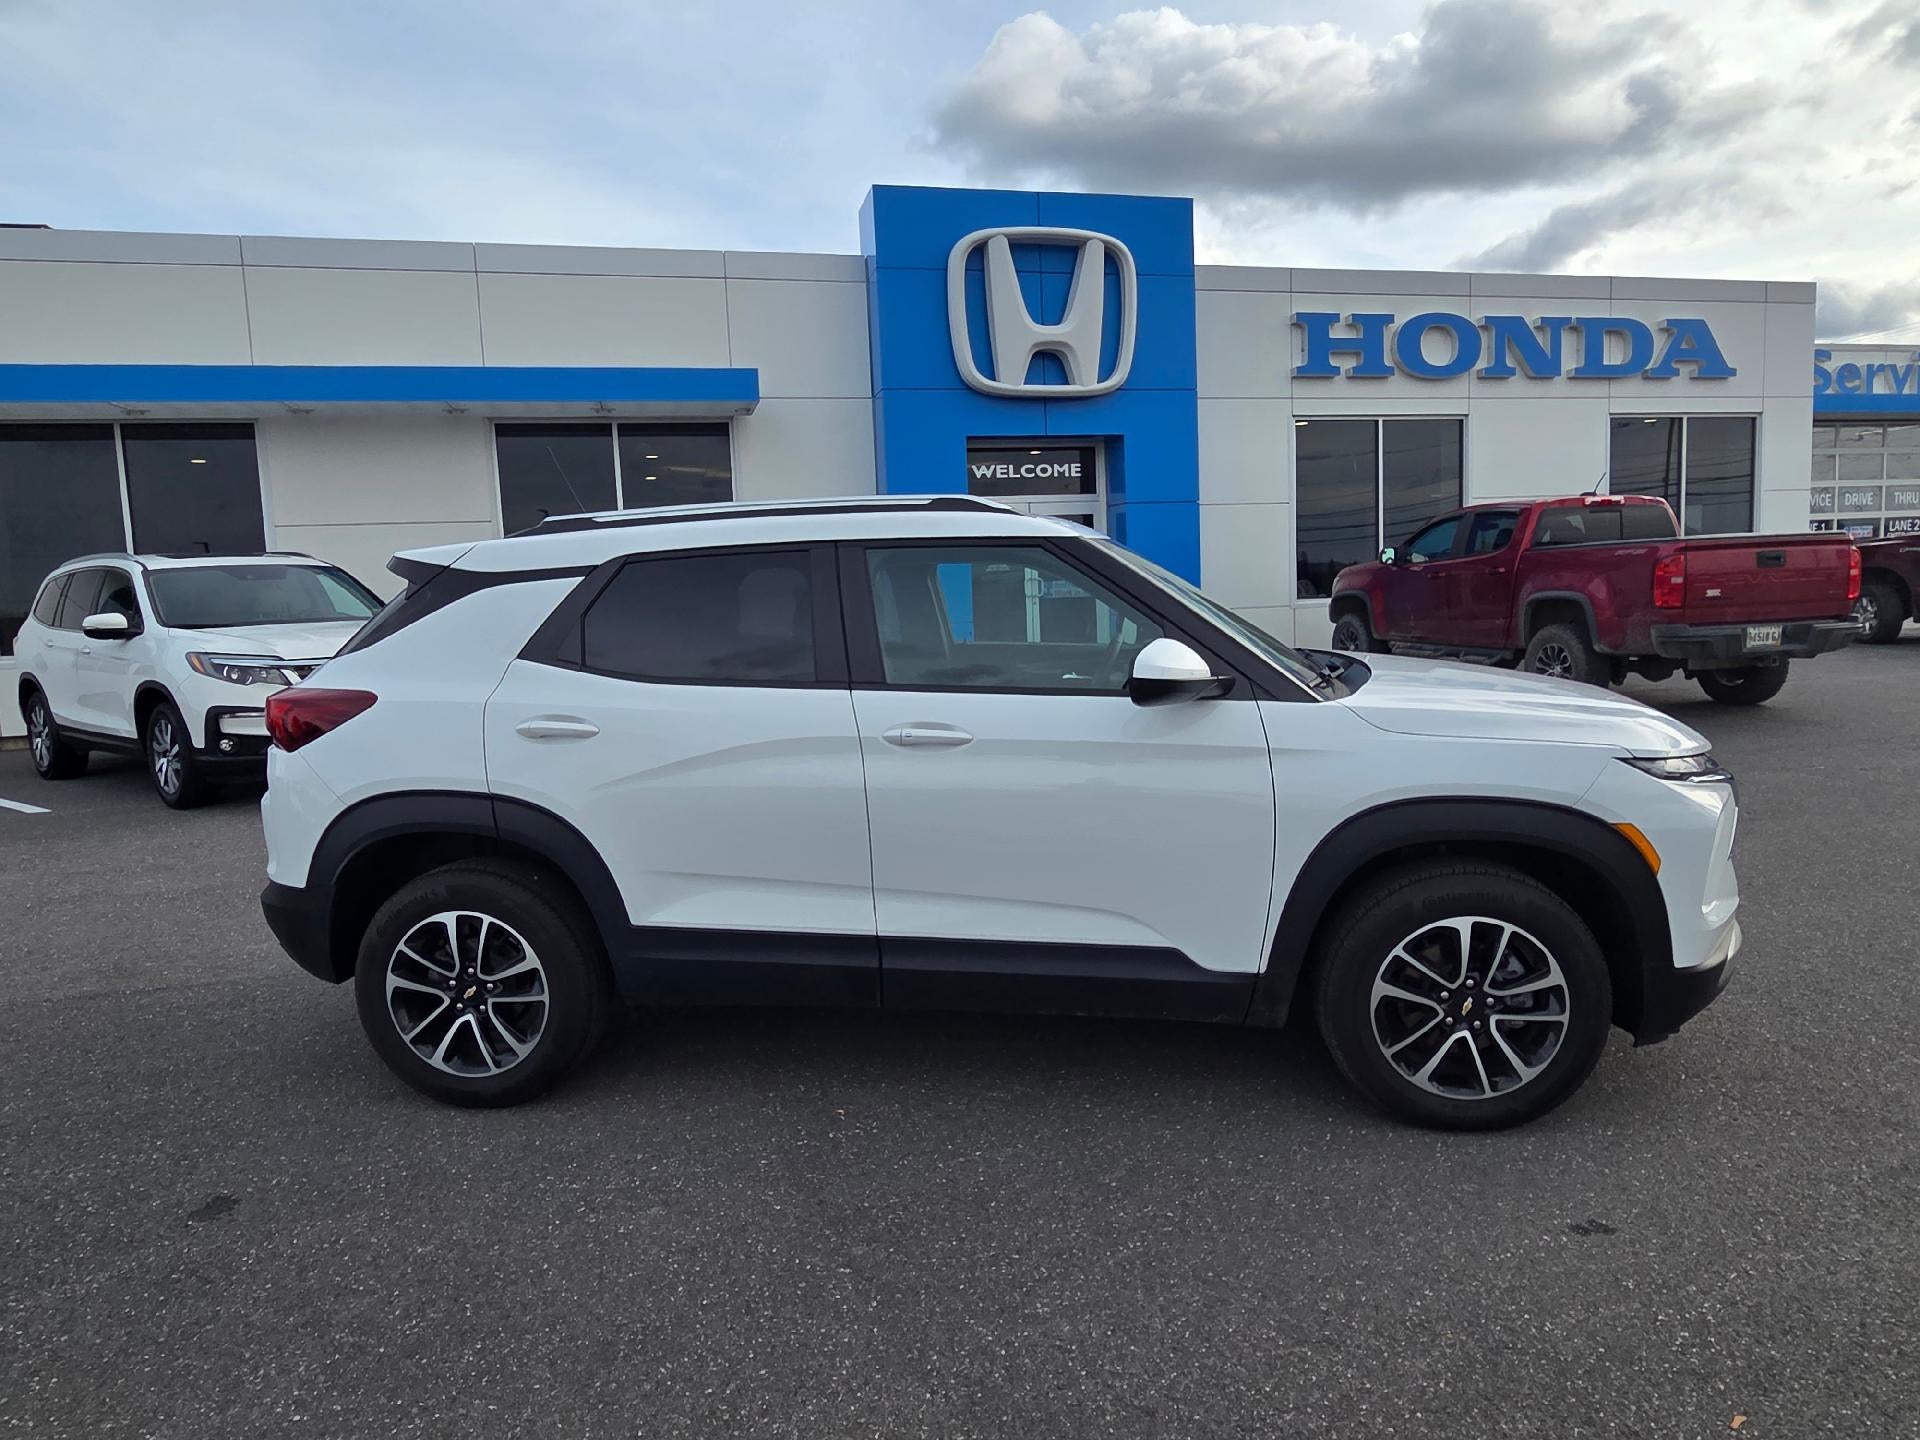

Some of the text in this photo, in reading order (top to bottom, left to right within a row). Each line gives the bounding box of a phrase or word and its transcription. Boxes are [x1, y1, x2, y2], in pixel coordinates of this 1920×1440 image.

[1291, 312, 1737, 379] HONDA
[972, 463, 1081, 478] WELCOME
[1845, 492, 1873, 505] DRIVE
[1894, 491, 1919, 504] THRU
[1889, 519, 1920, 531] LANE 2
